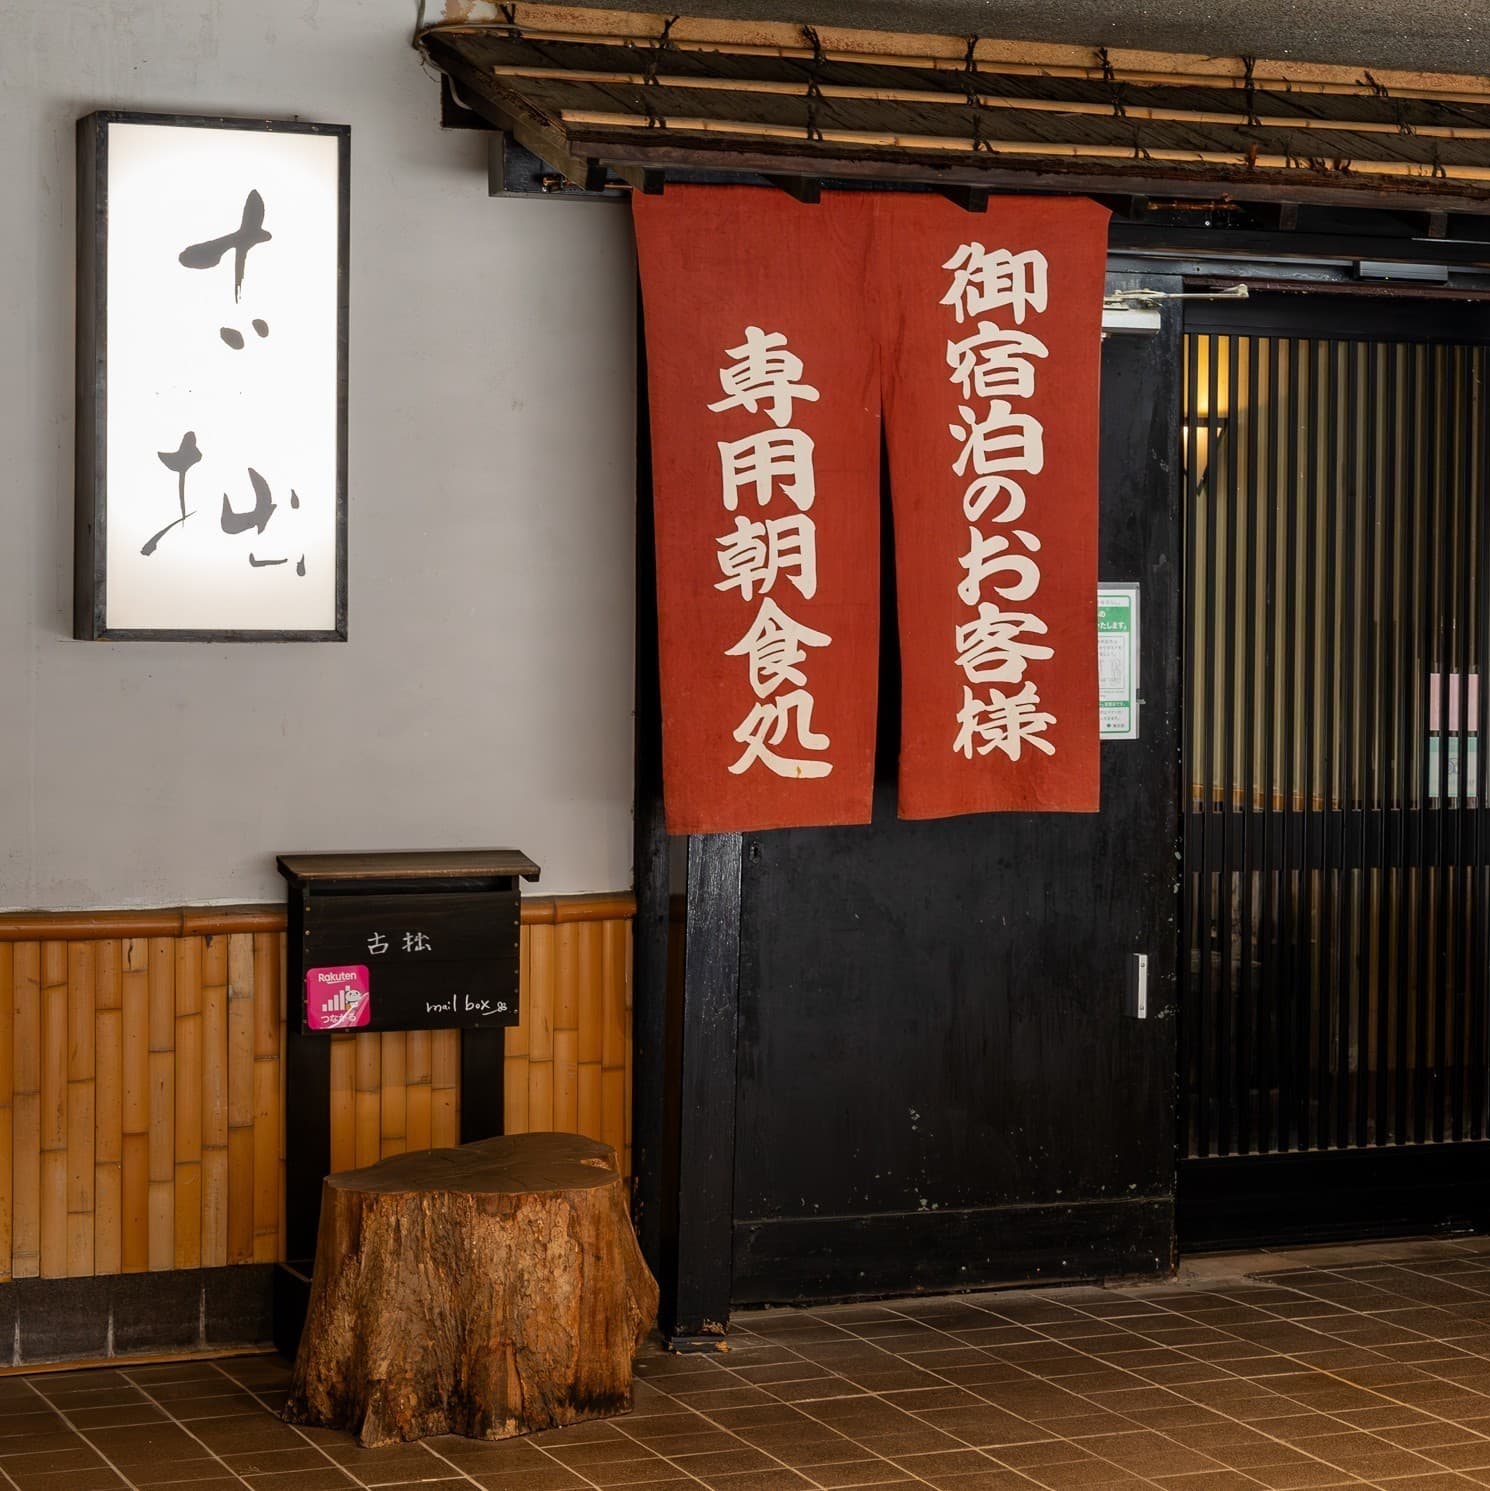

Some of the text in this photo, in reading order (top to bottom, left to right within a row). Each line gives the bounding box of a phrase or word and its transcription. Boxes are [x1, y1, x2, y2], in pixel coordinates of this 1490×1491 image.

[707, 325, 833, 779] 専用朝食処
[939, 241, 1057, 762] 御宿泊のお客様
[318, 972, 357, 984] Rakuten
[426, 993, 491, 1014] mail box
